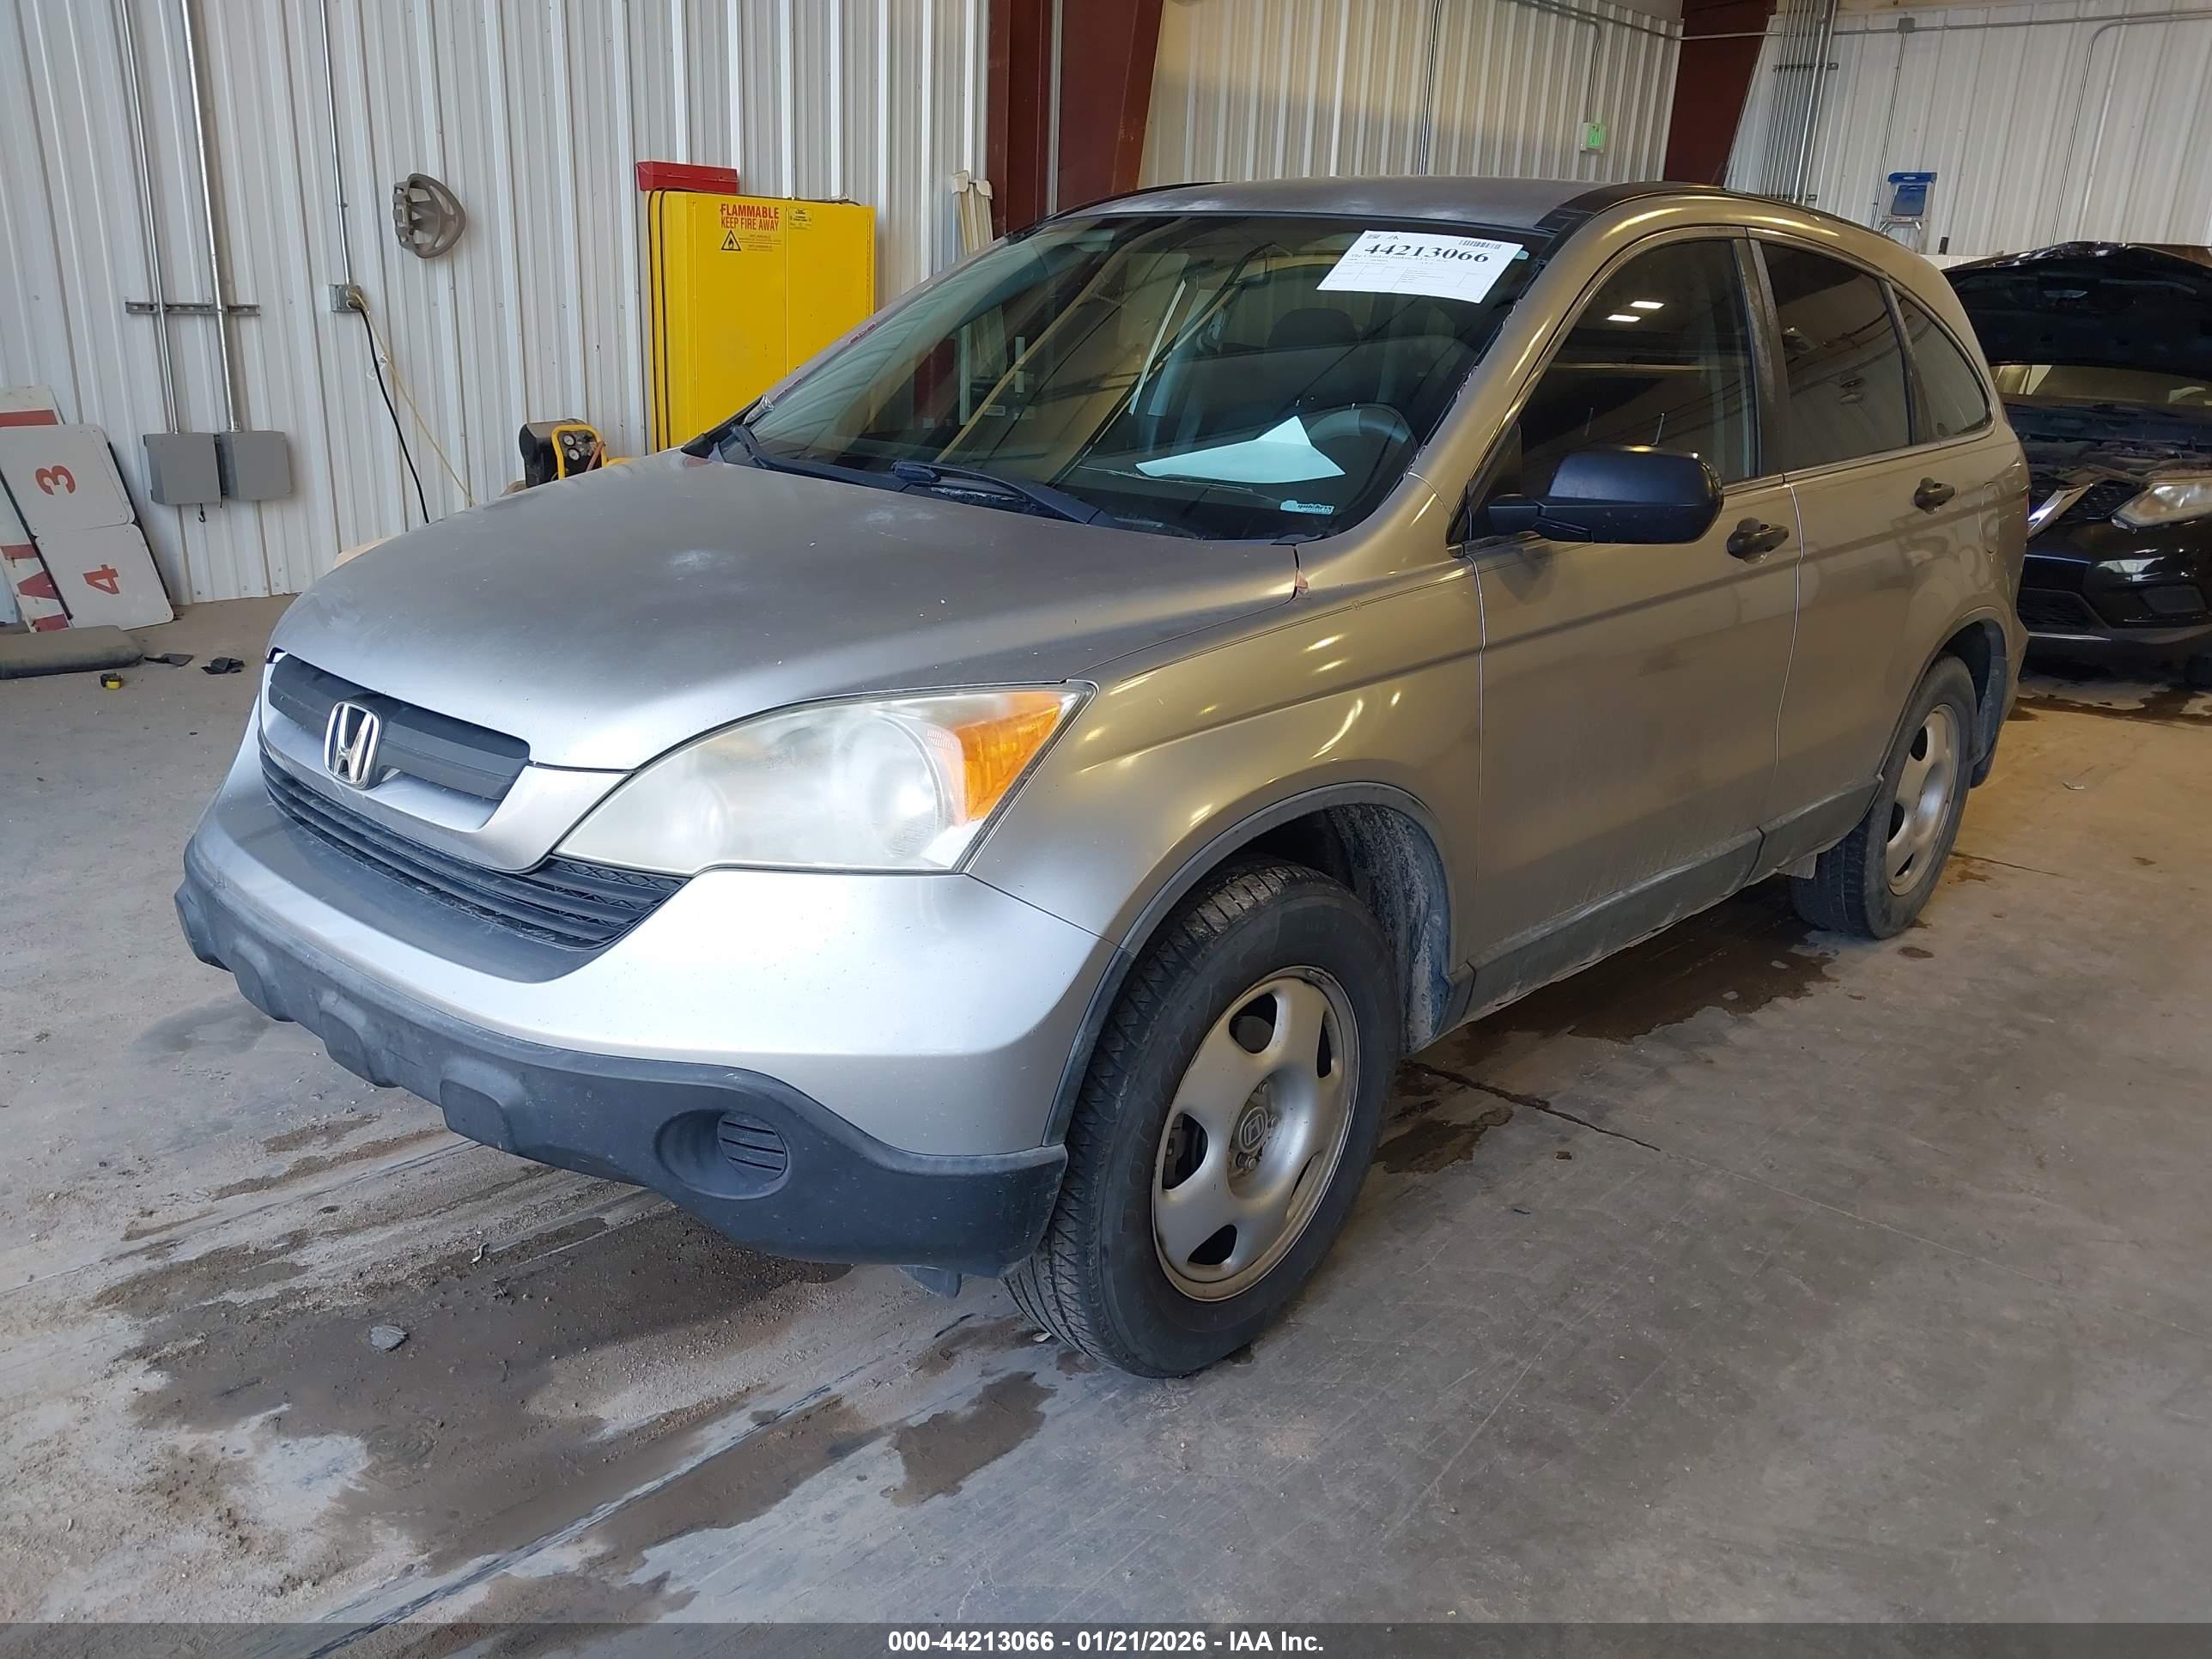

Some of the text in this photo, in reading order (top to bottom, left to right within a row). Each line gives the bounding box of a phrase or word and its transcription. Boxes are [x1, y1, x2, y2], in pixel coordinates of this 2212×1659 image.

[720, 203, 780, 219] FLAMMABLE
[721, 216, 738, 229] KEEP
[740, 217, 757, 230] FIRE
[758, 218, 779, 232] AWAY
[1364, 243, 1492, 263] 44213066
[35, 465, 76, 495] 3
[82, 563, 120, 595] 4
